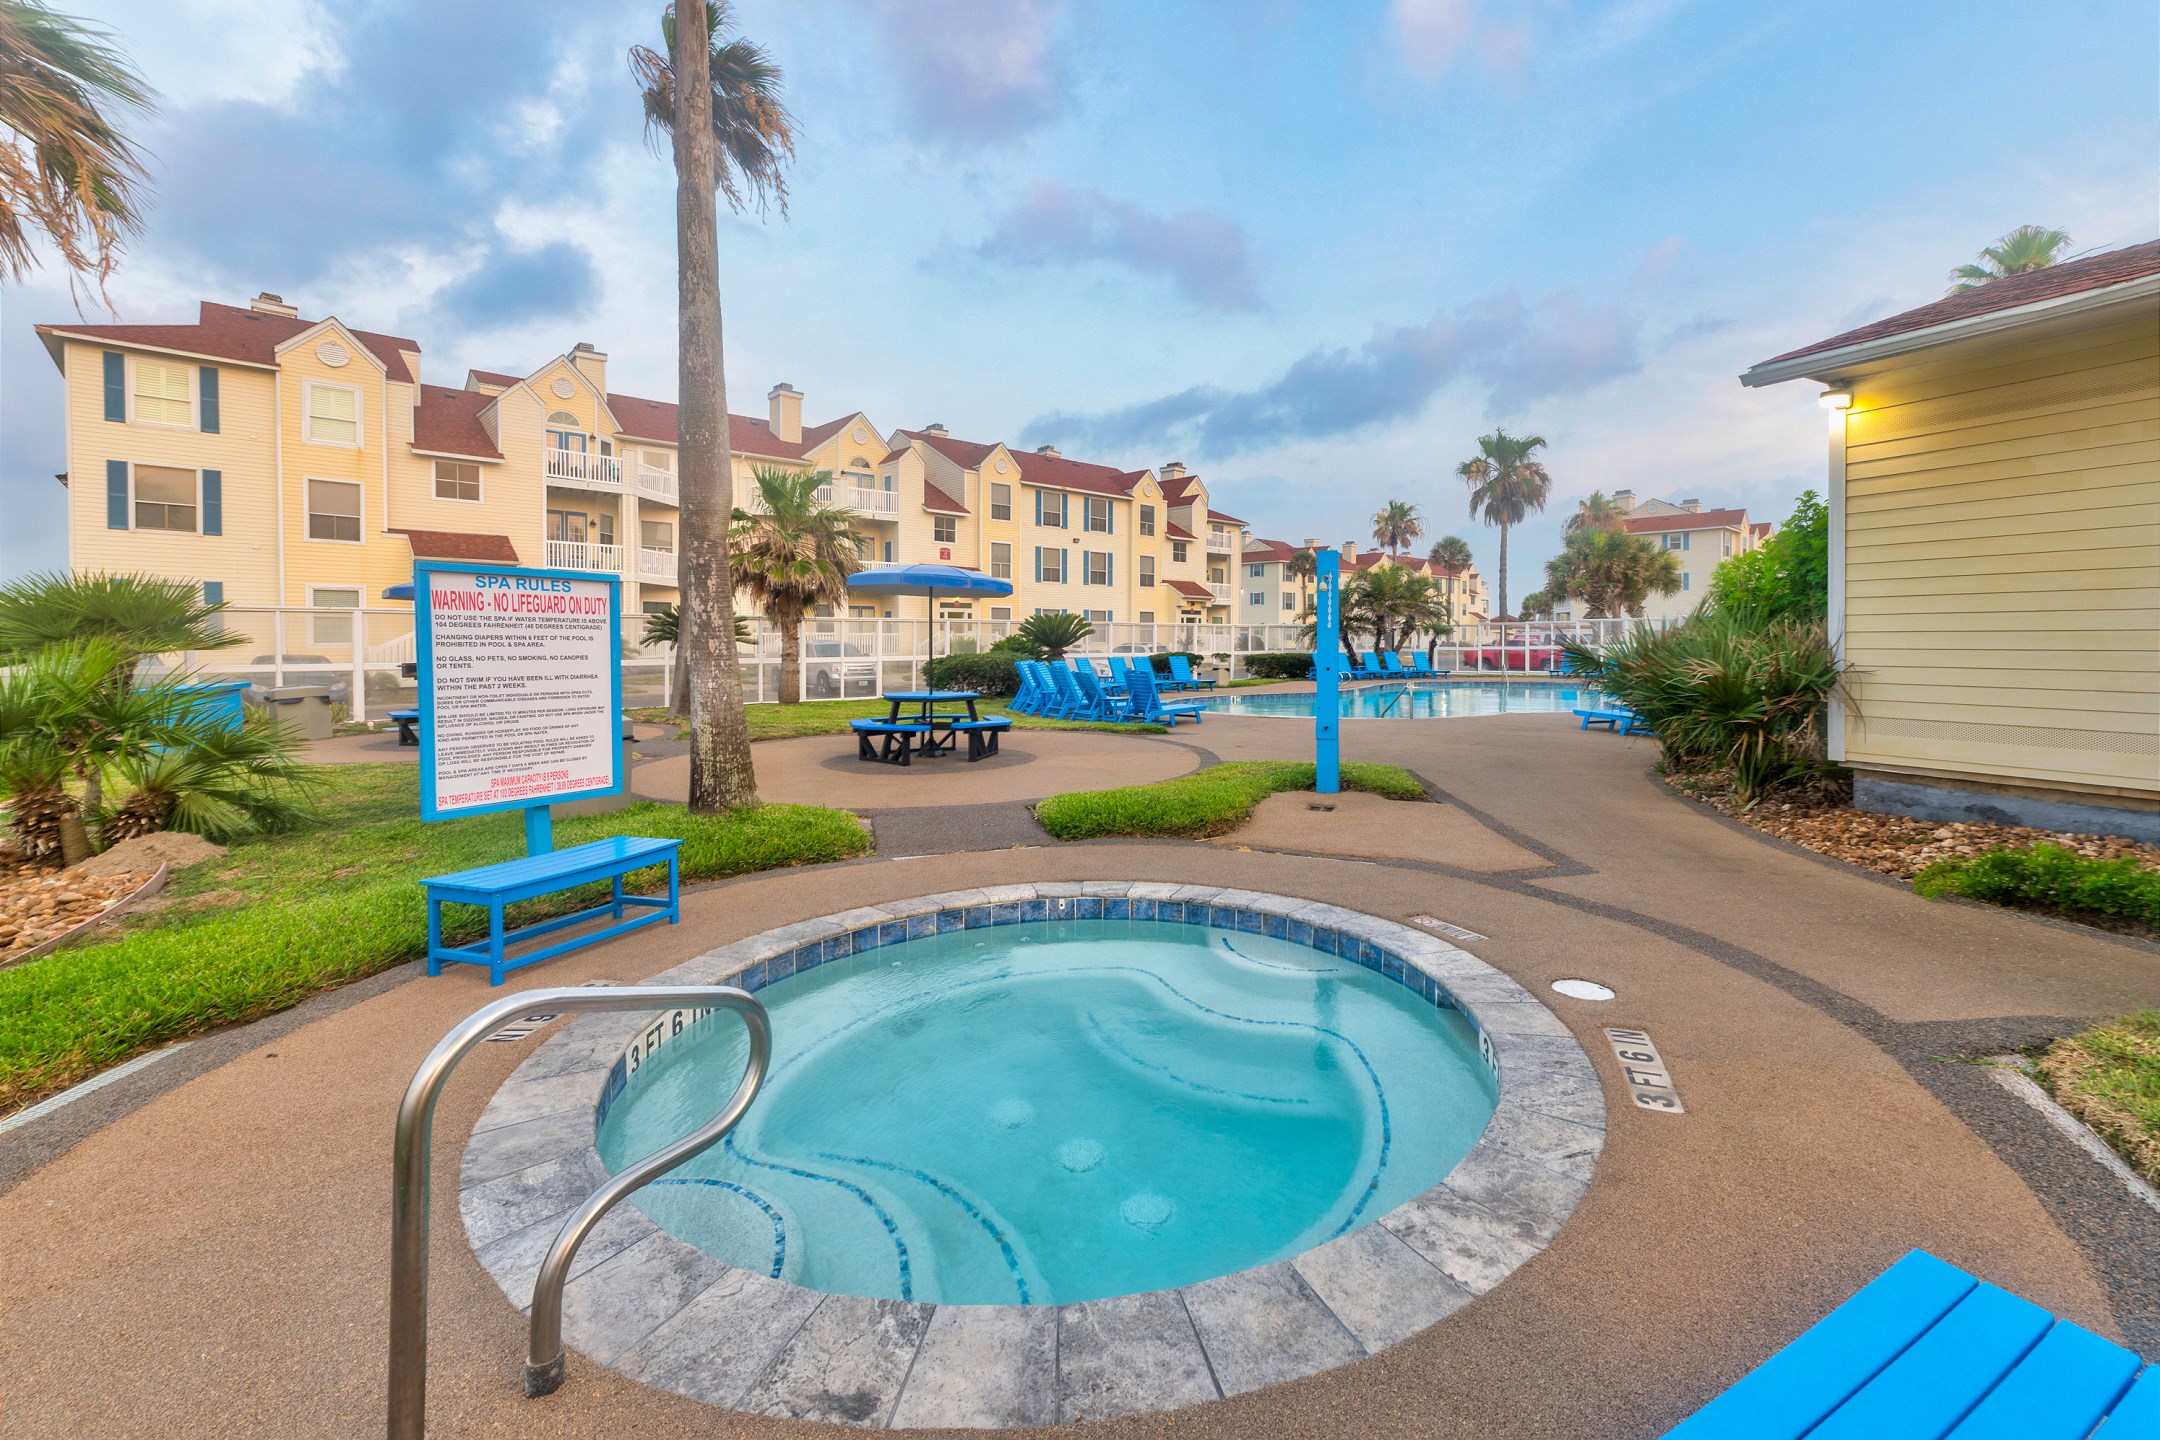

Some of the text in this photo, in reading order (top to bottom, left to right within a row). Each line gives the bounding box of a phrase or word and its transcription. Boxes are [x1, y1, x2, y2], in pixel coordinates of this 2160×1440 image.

[475, 575, 571, 592] SPA RULES
[431, 589, 484, 611] WARNING
[493, 592, 508, 612] NO
[511, 593, 566, 613] LIFEGUARD
[568, 595, 581, 614] ON
[584, 596, 607, 614] DUTY
[438, 795, 447, 807] SPA
[449, 791, 482, 806] TEMPERATURE
[483, 790, 492, 801] SET
[493, 789, 498, 799] AT
[507, 785, 528, 797] DEGREES
[566, 778, 584, 789] DEGREES
[490, 778, 499, 788] SPA
[500, 775, 520, 787] MAXIMUM
[521, 772, 541, 784] CAPACITY
[549, 769, 568, 780] PERSONS
[631, 1044, 640, 1074] 3
[646, 1022, 664, 1058] FT
[672, 1010, 683, 1036] 6
[1483, 1036, 1489, 1064] 3
[1610, 1029, 1676, 1108] 3 FT 6 IN
